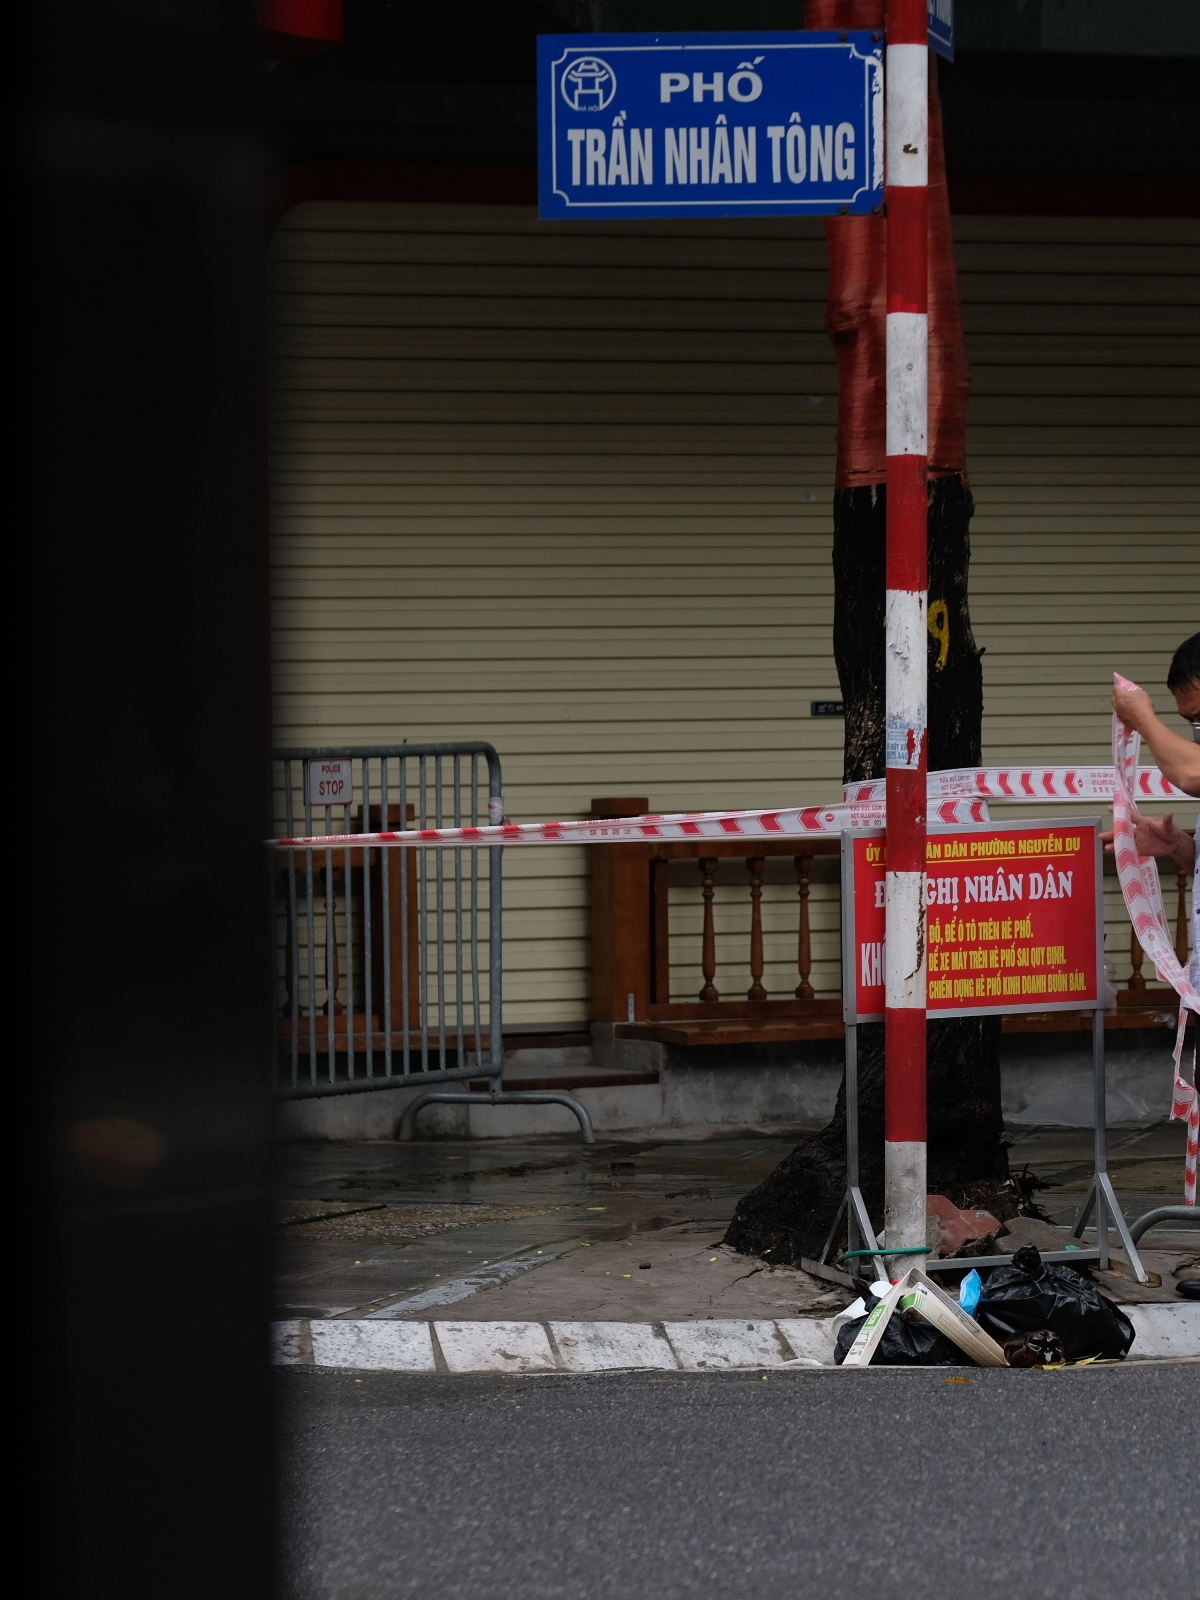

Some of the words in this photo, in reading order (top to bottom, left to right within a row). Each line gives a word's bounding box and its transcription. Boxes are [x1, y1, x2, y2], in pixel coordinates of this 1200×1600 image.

[660, 56, 765, 104] PHỐ
[567, 110, 653, 187] TRẦN
[664, 114, 757, 186] NHÂN
[767, 112, 856, 184] TÔNG
[321, 764, 341, 773] POLICE
[319, 780, 344, 796] STOP
[866, 843, 880, 862] ỦY
[944, 840, 968, 858] DÂN
[970, 838, 1016, 857] PHƯỜNG
[1018, 833, 1063, 854] NGUYỄN
[1065, 837, 1081, 852] DU
[926, 877, 959, 912] GHỊ
[964, 866, 1024, 903] NHÂN
[1028, 863, 1074, 900] DÂN
[957, 919, 964, 942] Ô
[965, 918, 977, 942] TÔ
[978, 917, 1000, 941] TRÊN
[1001, 916, 1013, 940] HÈ
[1014, 912, 1034, 940] PHỐ.
[939, 952, 950, 971] XE
[951, 947, 968, 970] MÁY
[968, 946, 988, 970] TRÊN
[989, 945, 999, 969] HÈ
[1000, 941, 1016, 968] PHỐ
[1017, 947, 1030, 967] SAI
[1030, 946, 1046, 969] QUY
[929, 974, 953, 999] CHIẾM
[953, 978, 975, 1002] DỤNG
[975, 973, 986, 997] HÈ
[986, 969, 1002, 996] PHỐ
[1002, 975, 1021, 996] KINH
[1021, 973, 1047, 994] DOANH
[1047, 969, 1068, 993] BUÔN
